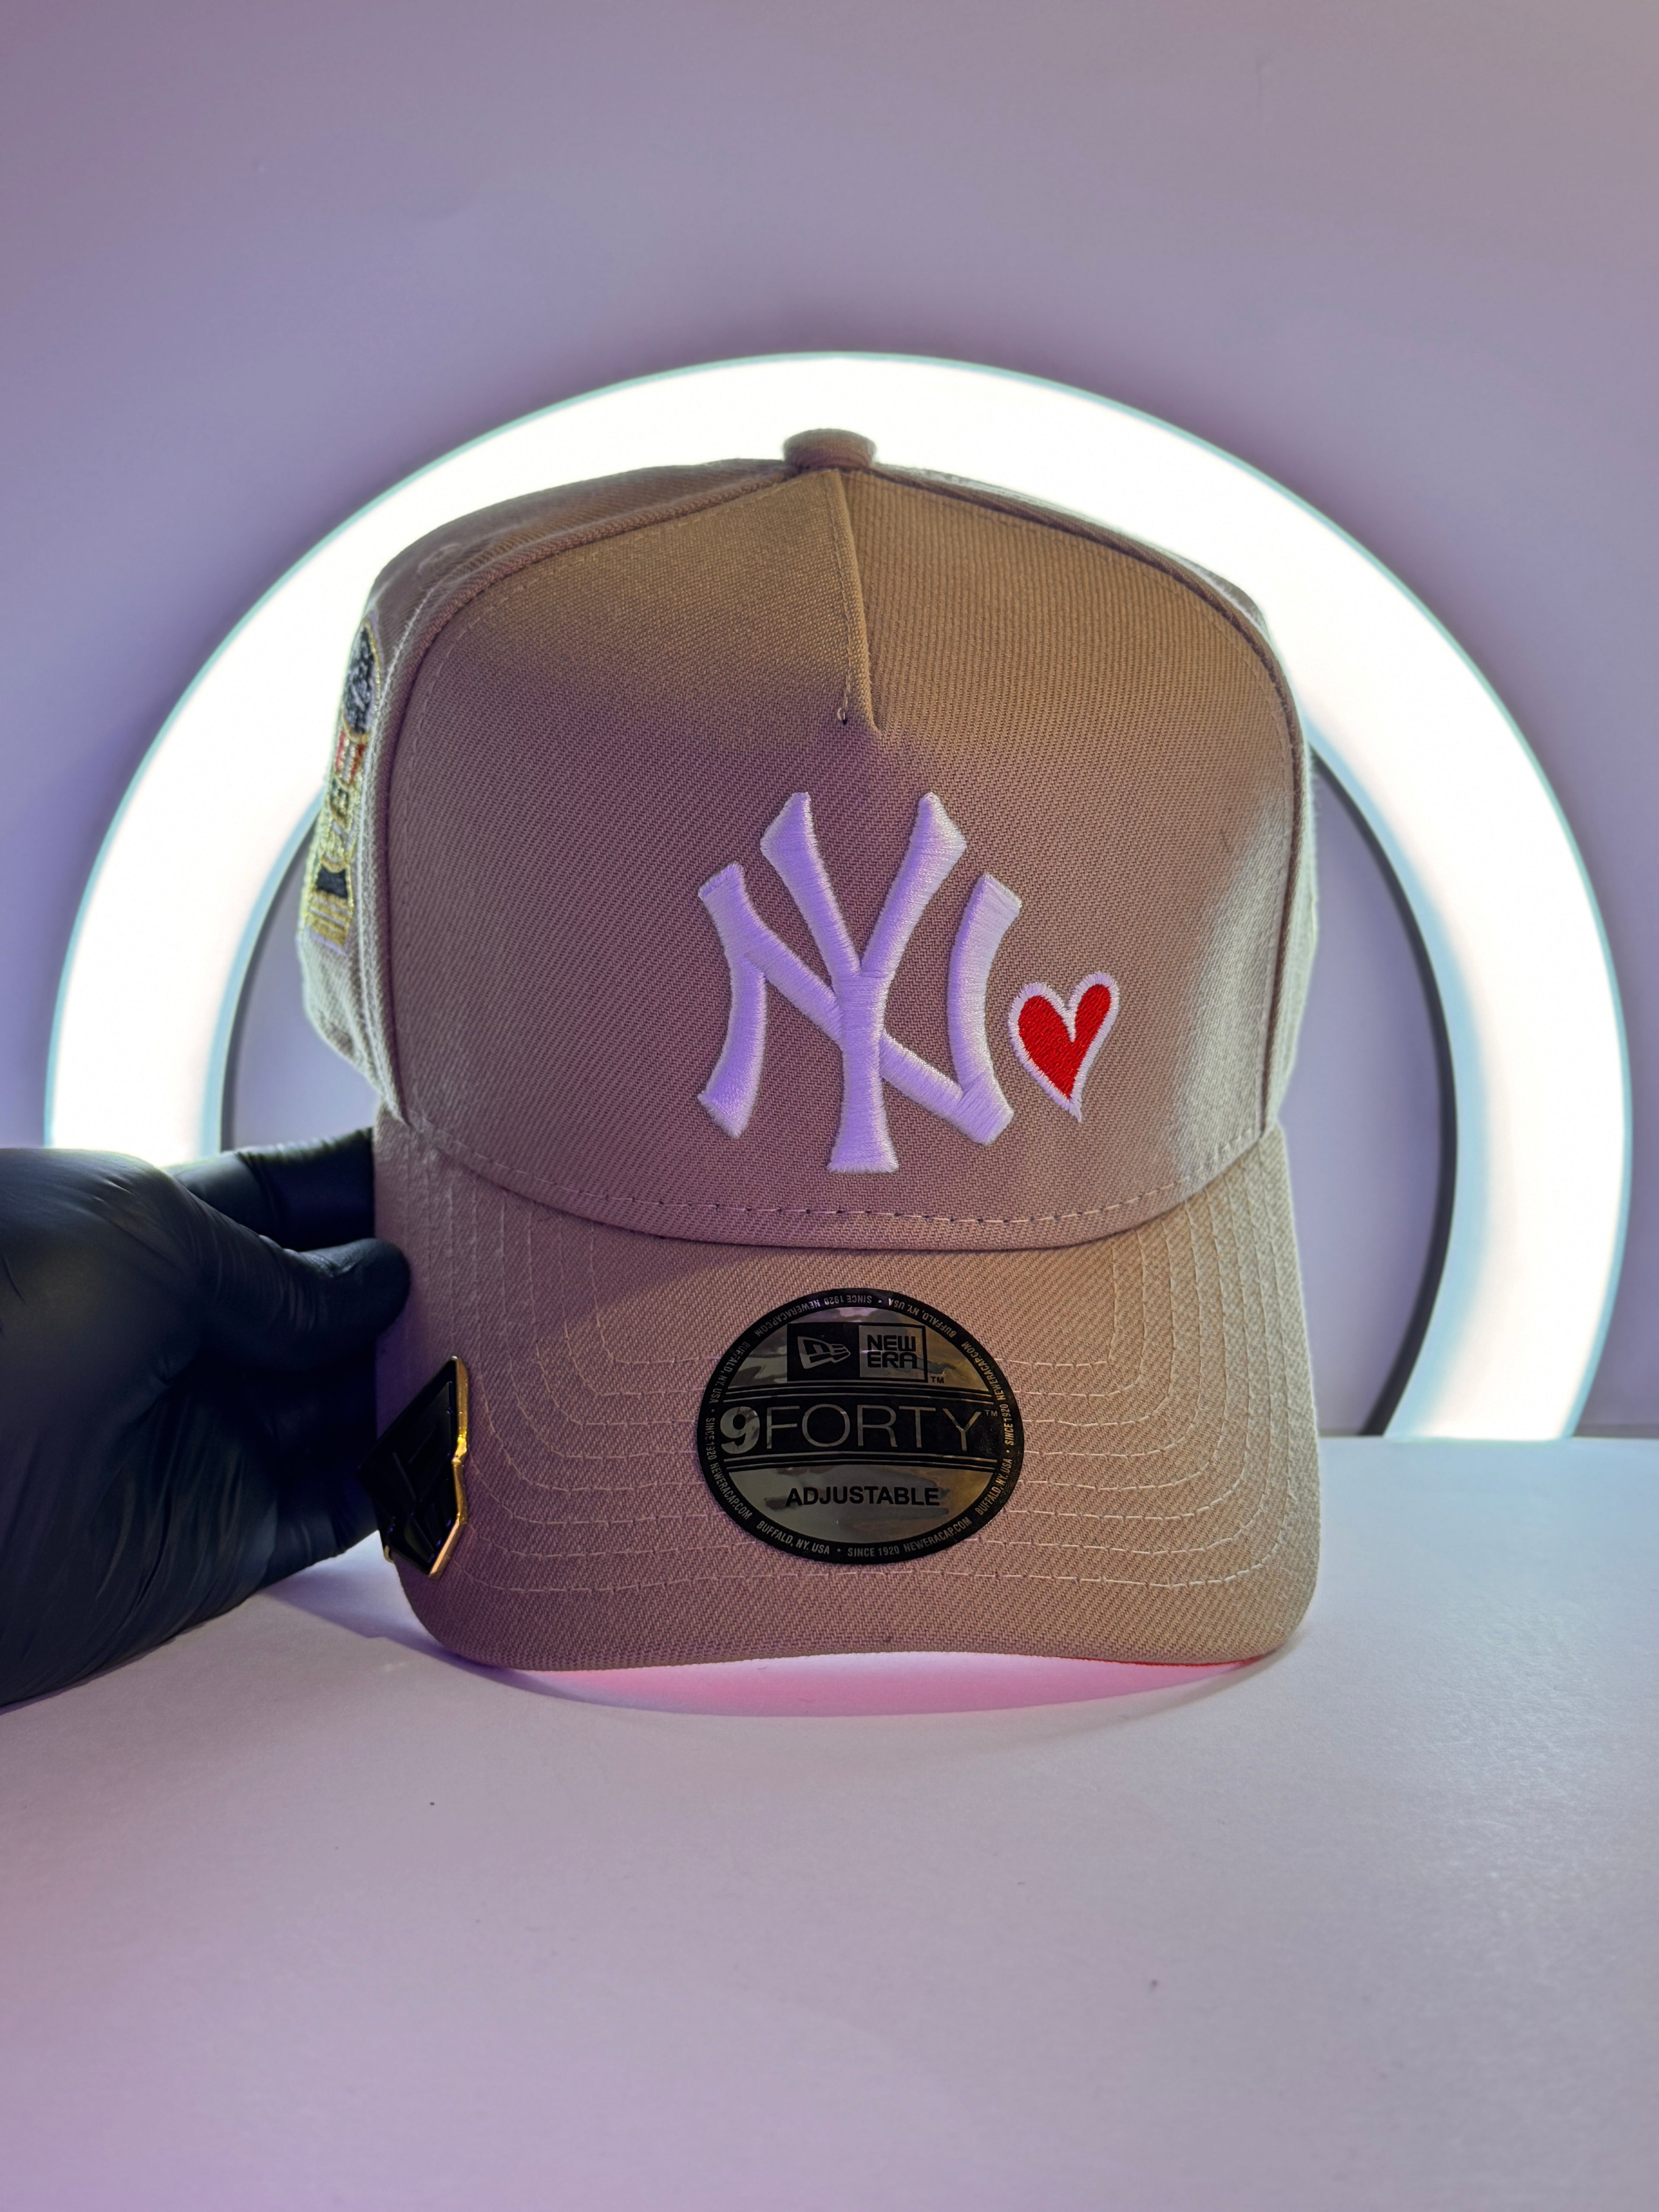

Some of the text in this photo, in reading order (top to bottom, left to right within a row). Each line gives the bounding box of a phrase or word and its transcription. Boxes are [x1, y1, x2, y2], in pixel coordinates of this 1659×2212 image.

[867, 1335, 916, 1351] NEW
[867, 1351, 918, 1369] ERA
[720, 1404, 982, 1454] 9FORTY
[785, 1486, 940, 1506] ADJUSTABLE
[811, 1543, 830, 1554] USA
[847, 1548, 875, 1557] SINCE
[877, 1546, 899, 1556] 1920
